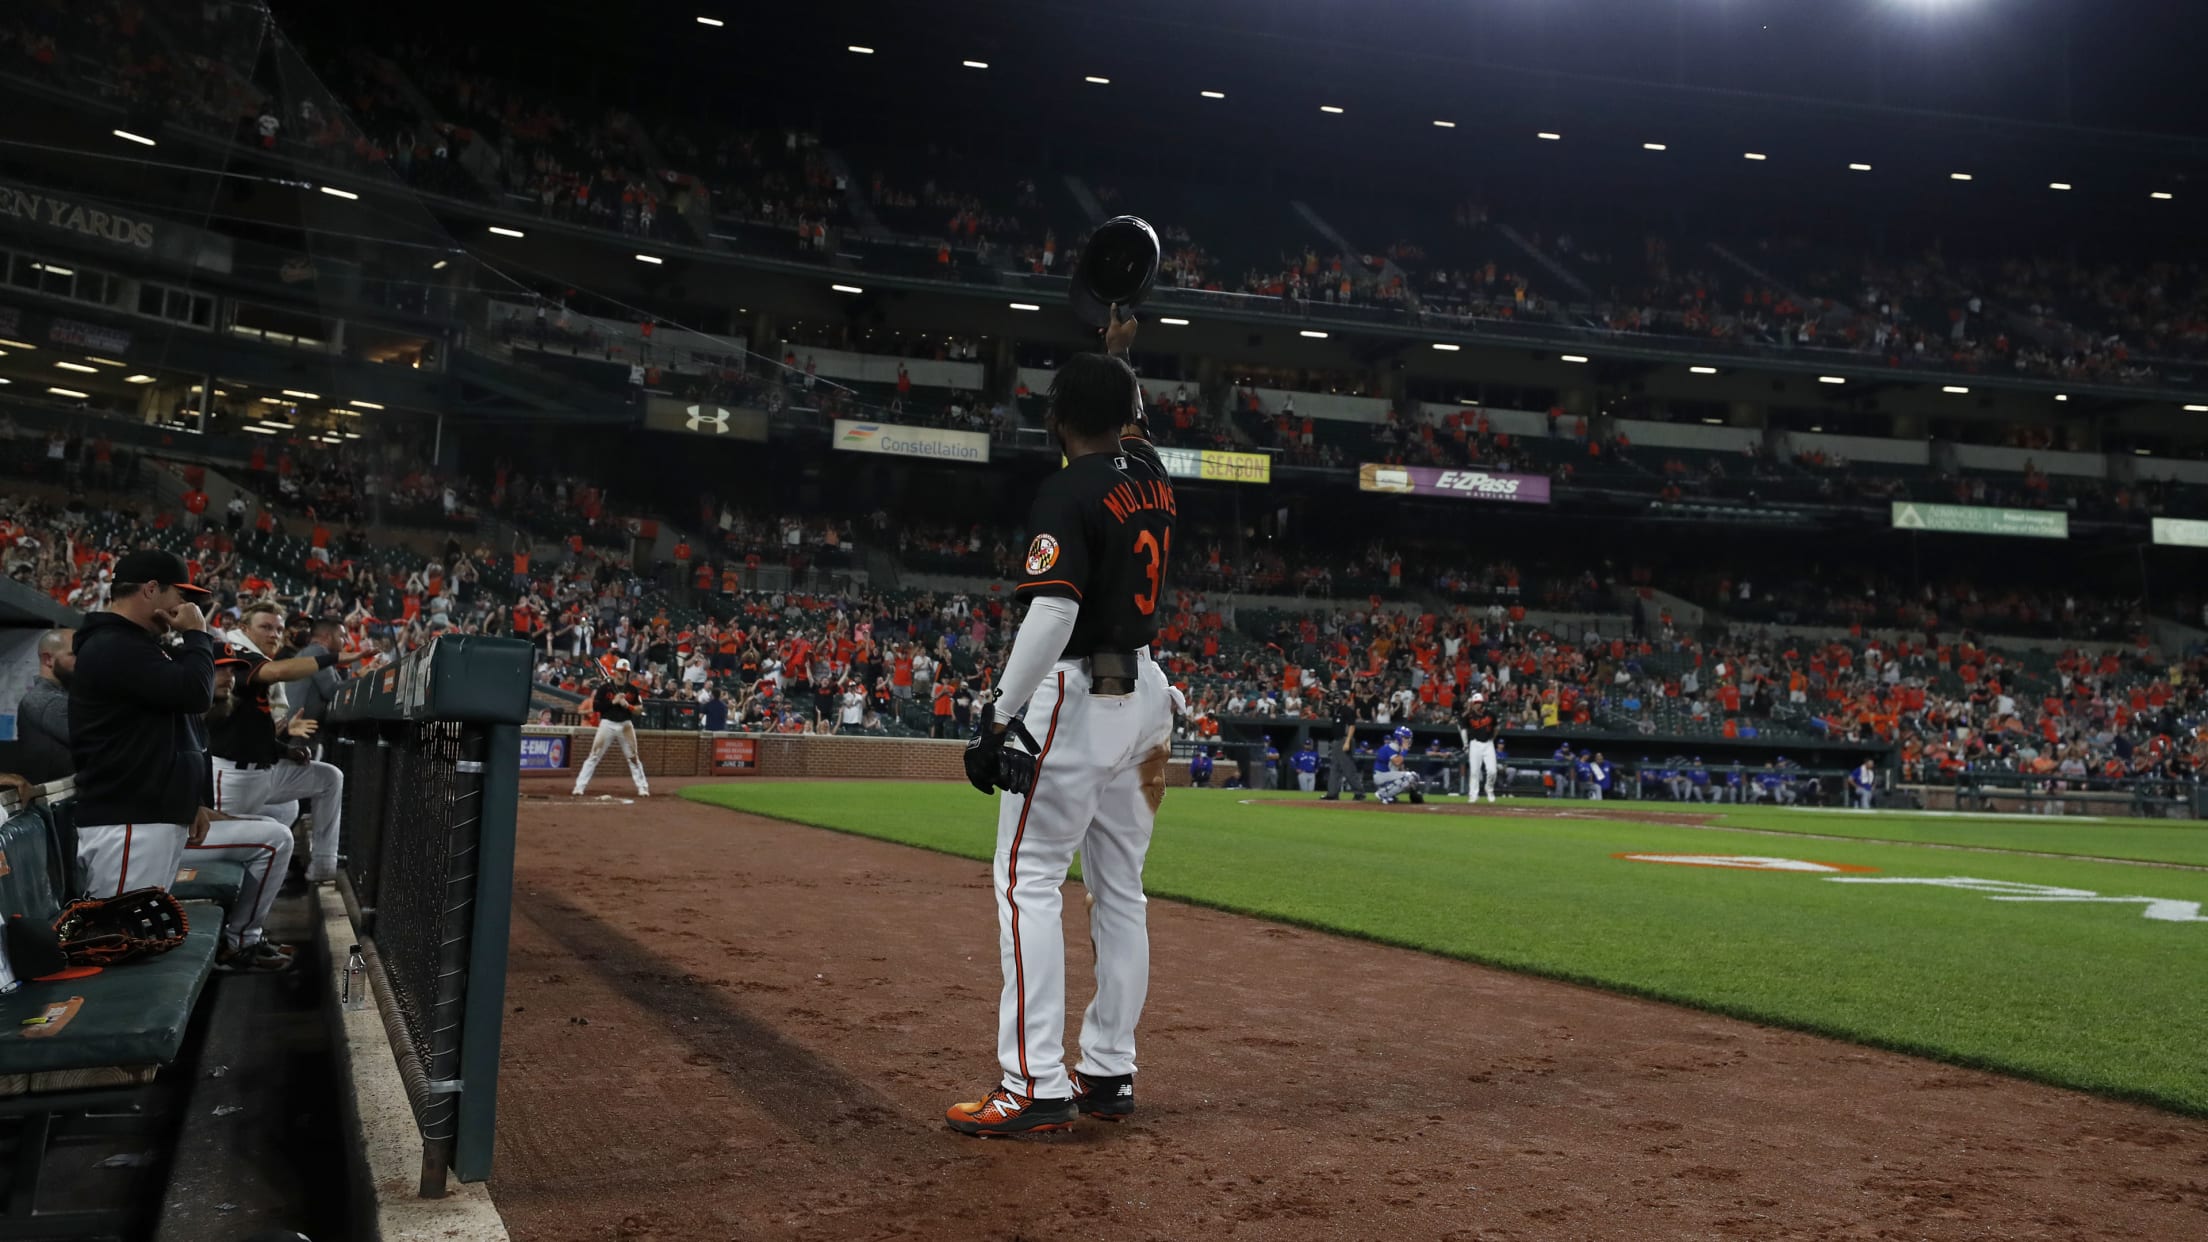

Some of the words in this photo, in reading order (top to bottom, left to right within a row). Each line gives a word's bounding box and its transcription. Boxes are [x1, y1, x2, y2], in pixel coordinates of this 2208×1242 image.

[45, 197, 154, 249] YARDS
[880, 436, 978, 459] Constellation
[1206, 454, 1265, 479] SEASON
[1436, 471, 1519, 493] E-ZPass
